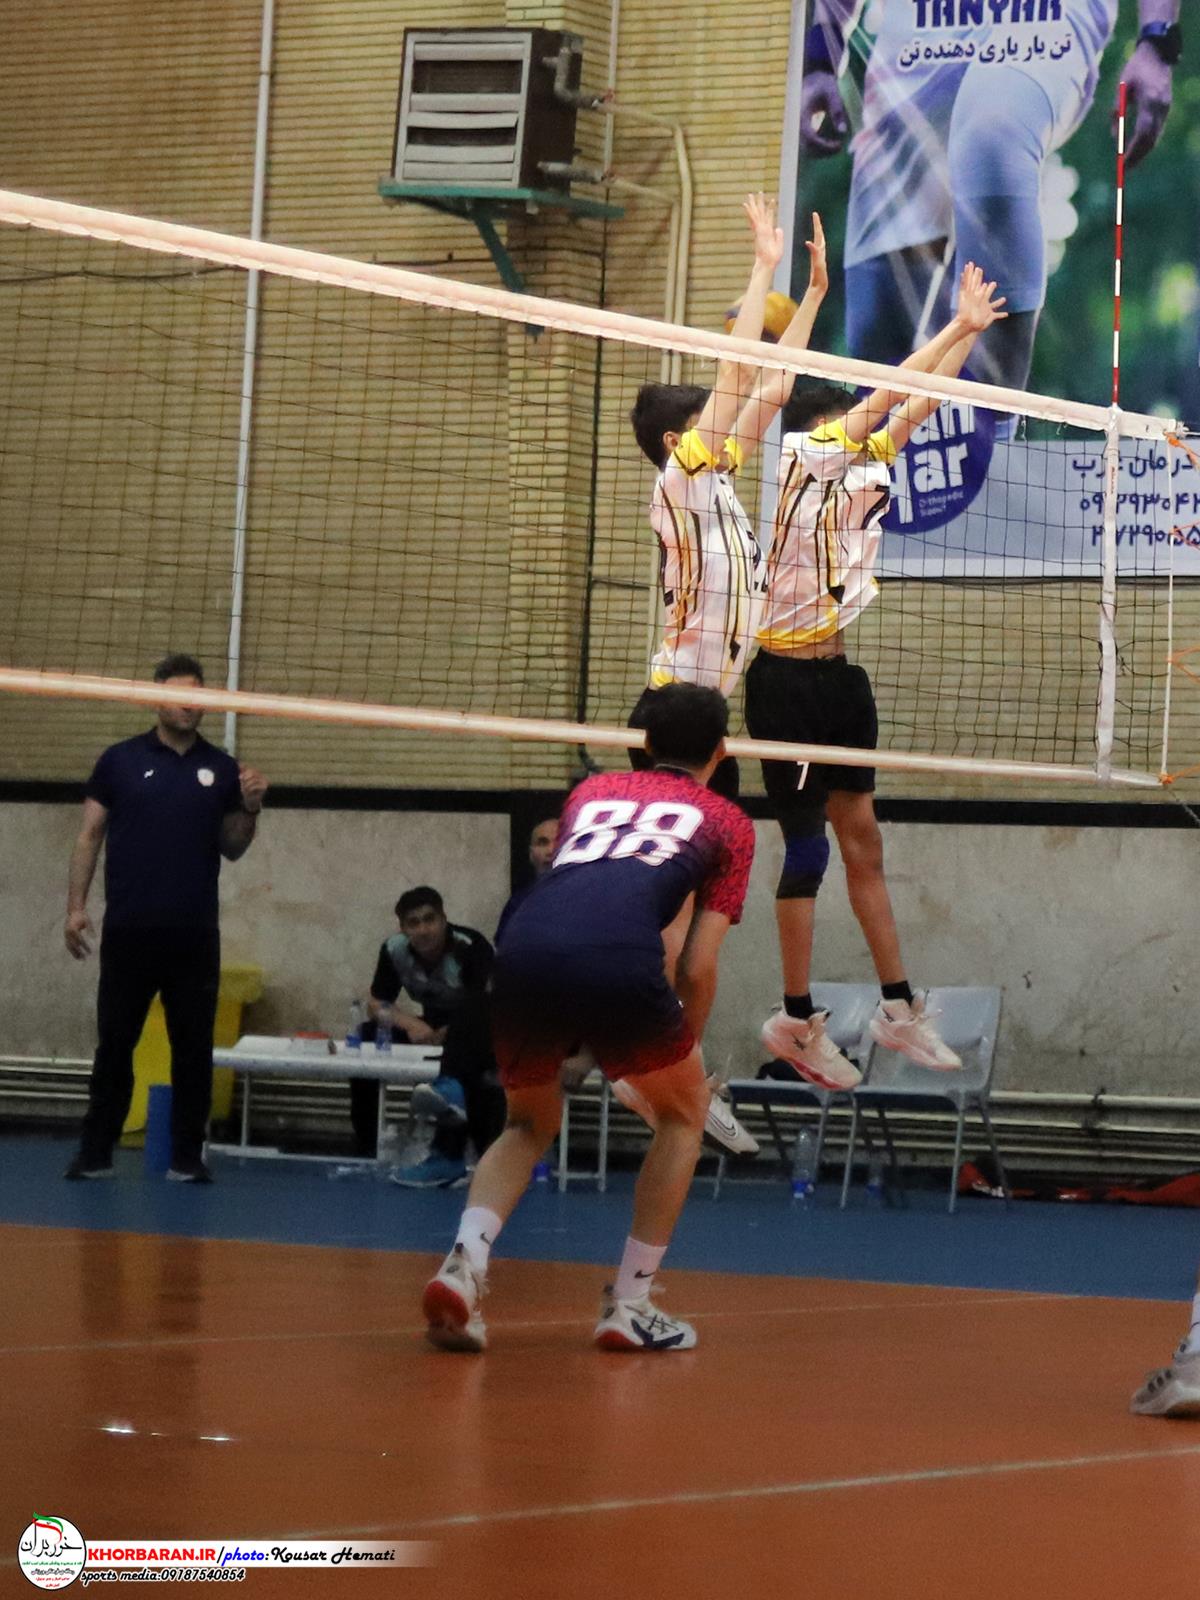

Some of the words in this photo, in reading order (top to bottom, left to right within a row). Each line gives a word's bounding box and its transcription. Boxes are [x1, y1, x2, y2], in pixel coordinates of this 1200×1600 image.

[900, 42, 920, 67] تن
[923, 42, 975, 60] دهنده
[979, 36, 1018, 63] یاری
[1024, 35, 1045, 62] یار
[1050, 34, 1072, 60] تن
[552, 800, 705, 868] 88
